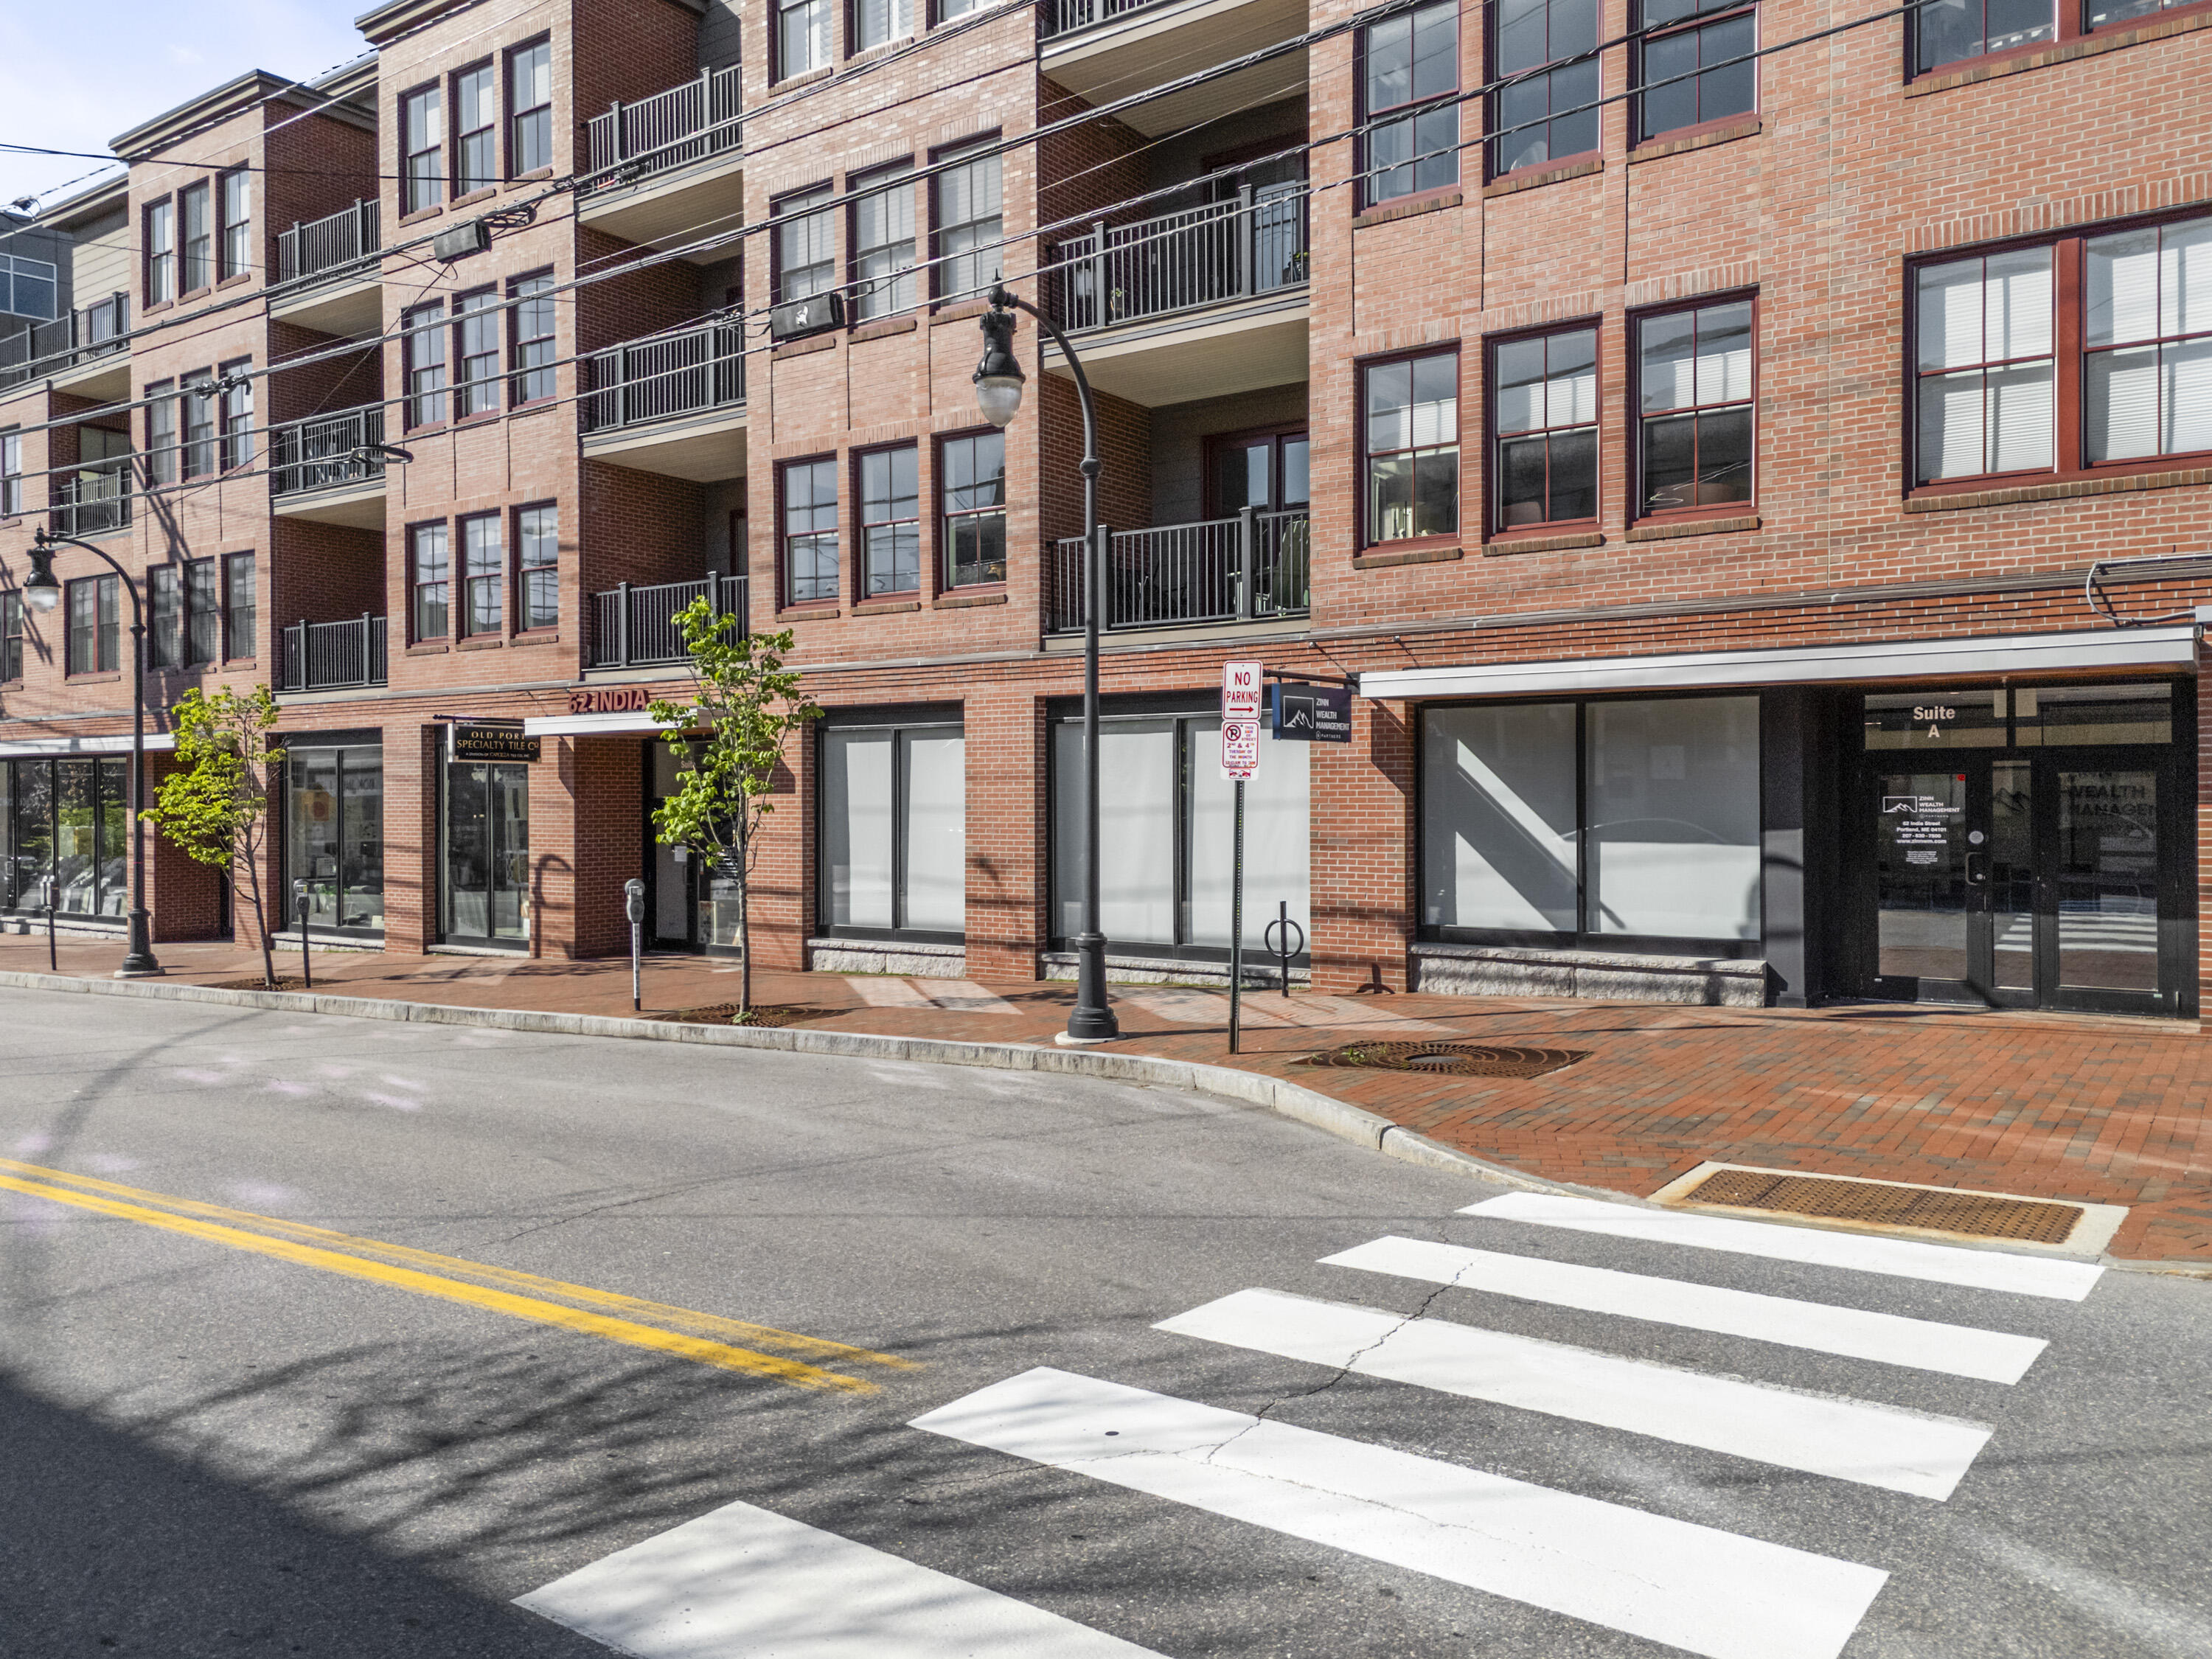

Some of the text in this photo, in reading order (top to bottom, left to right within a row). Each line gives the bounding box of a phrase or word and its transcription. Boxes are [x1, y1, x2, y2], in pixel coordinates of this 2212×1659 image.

[1235, 672, 1251, 686] NO
[568, 689, 647, 713] 62 INDIA
[1226, 691, 1258, 703] PARKING
[1316, 698, 1329, 706] ZINN
[1316, 711, 1337, 719] WEALTH
[1913, 706, 1955, 720] Suite
[1316, 722, 1349, 731] MANAGEMENT
[1928, 724, 1940, 737] A
[471, 731, 525, 740] OLD PORT
[457, 739, 505, 749] SPECIALTY
[509, 741, 525, 750] TILE
